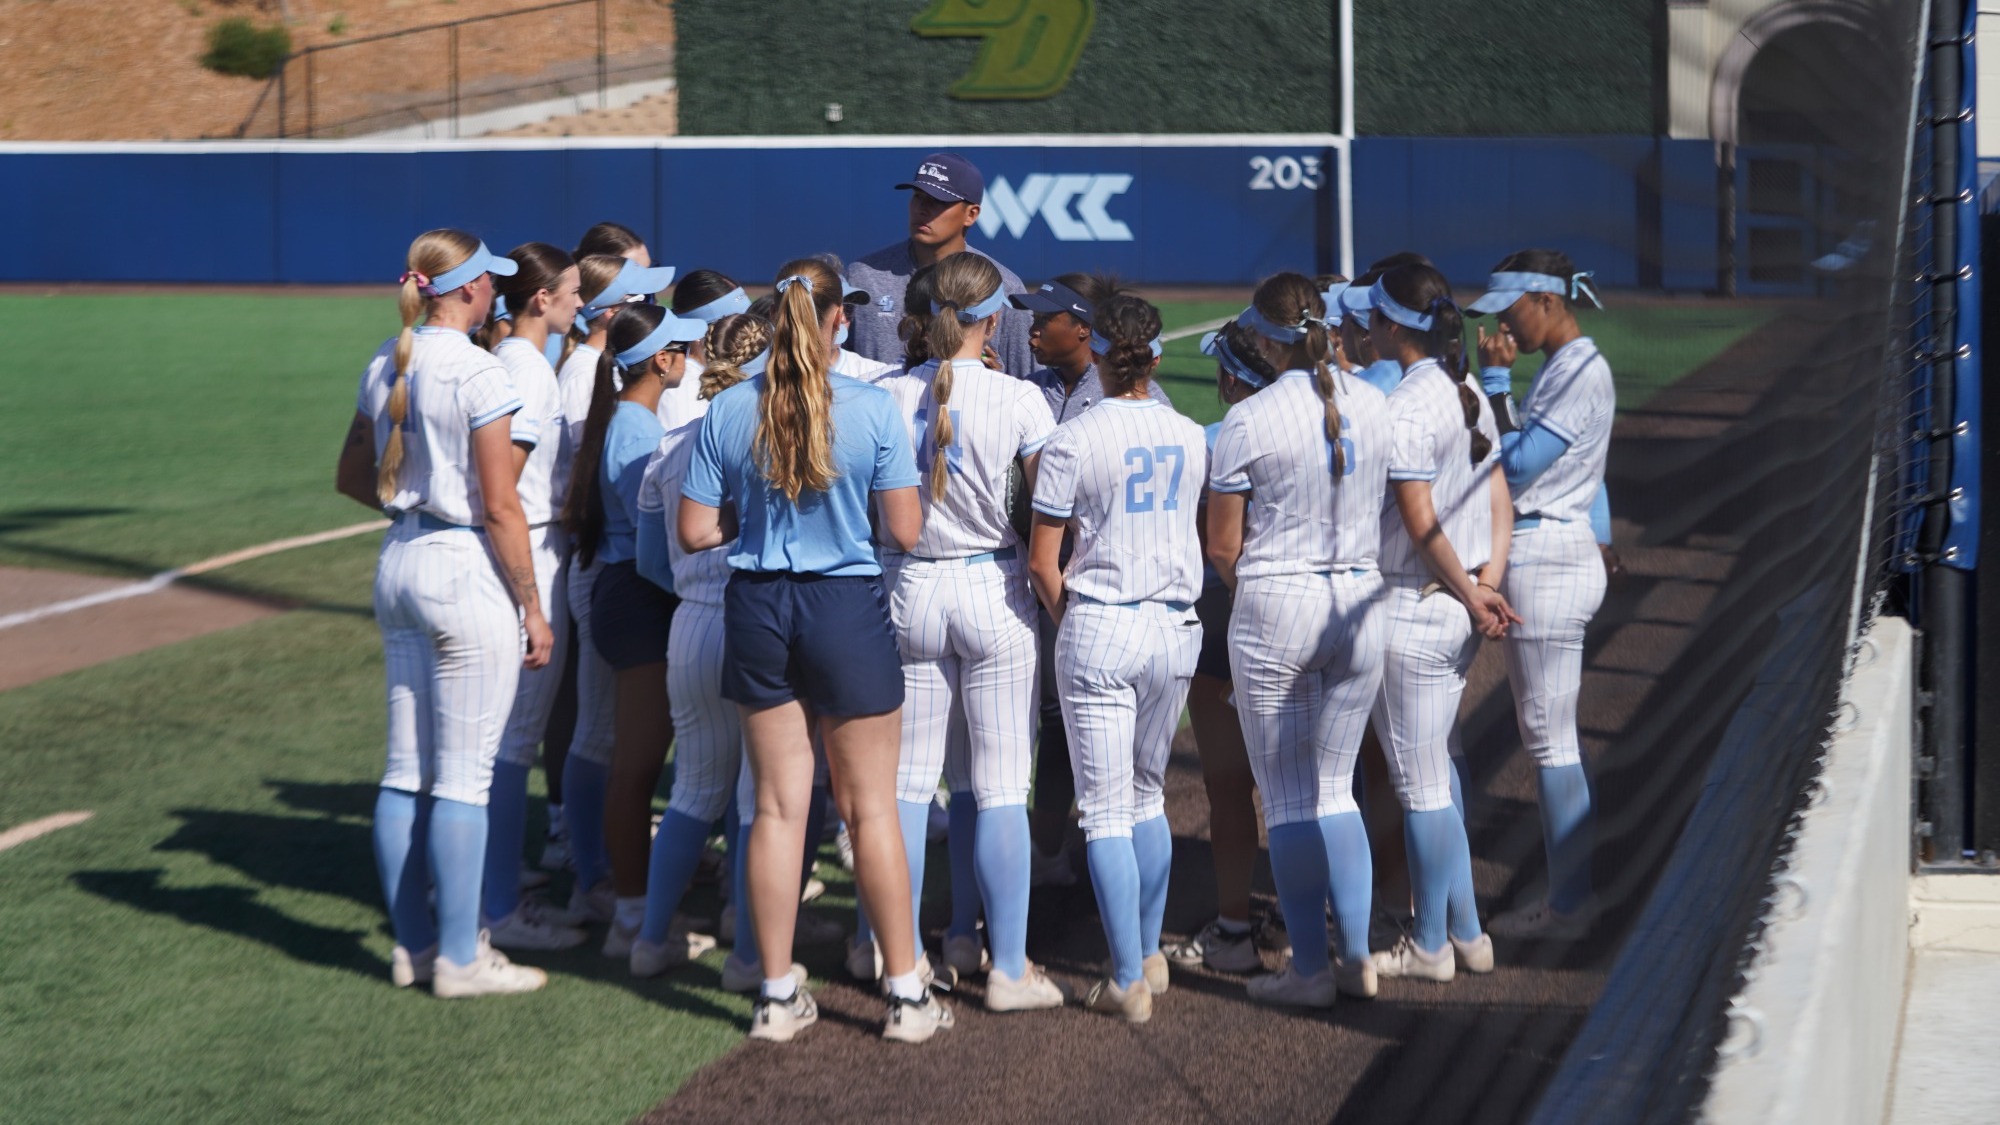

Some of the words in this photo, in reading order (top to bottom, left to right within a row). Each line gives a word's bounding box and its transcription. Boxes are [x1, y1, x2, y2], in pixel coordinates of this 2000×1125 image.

[1248, 155, 1326, 190] 203
[976, 173, 1134, 241] WCC
[1124, 445, 1185, 513] 27
